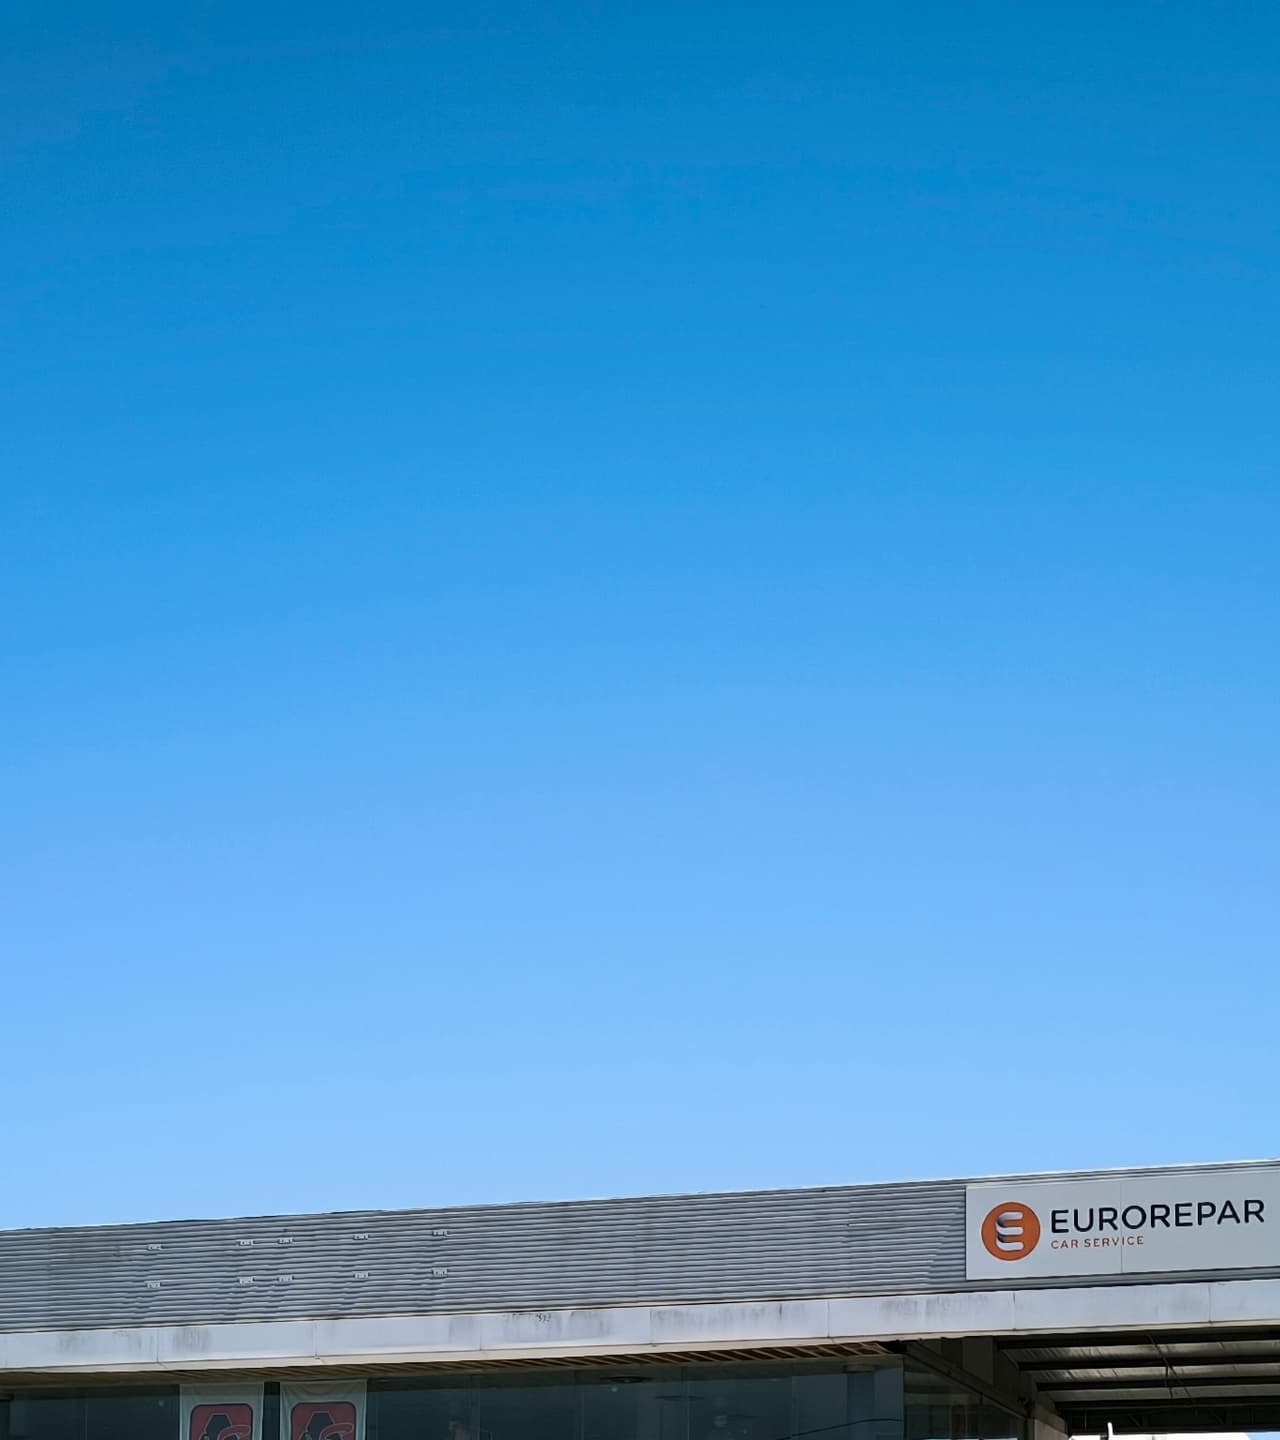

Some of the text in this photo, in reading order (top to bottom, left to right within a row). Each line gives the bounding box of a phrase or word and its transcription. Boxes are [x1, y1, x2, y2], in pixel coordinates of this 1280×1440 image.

[1051, 1199, 1265, 1234] EUROREPAR
[1051, 1236, 1144, 1250] CAR SERVICE
